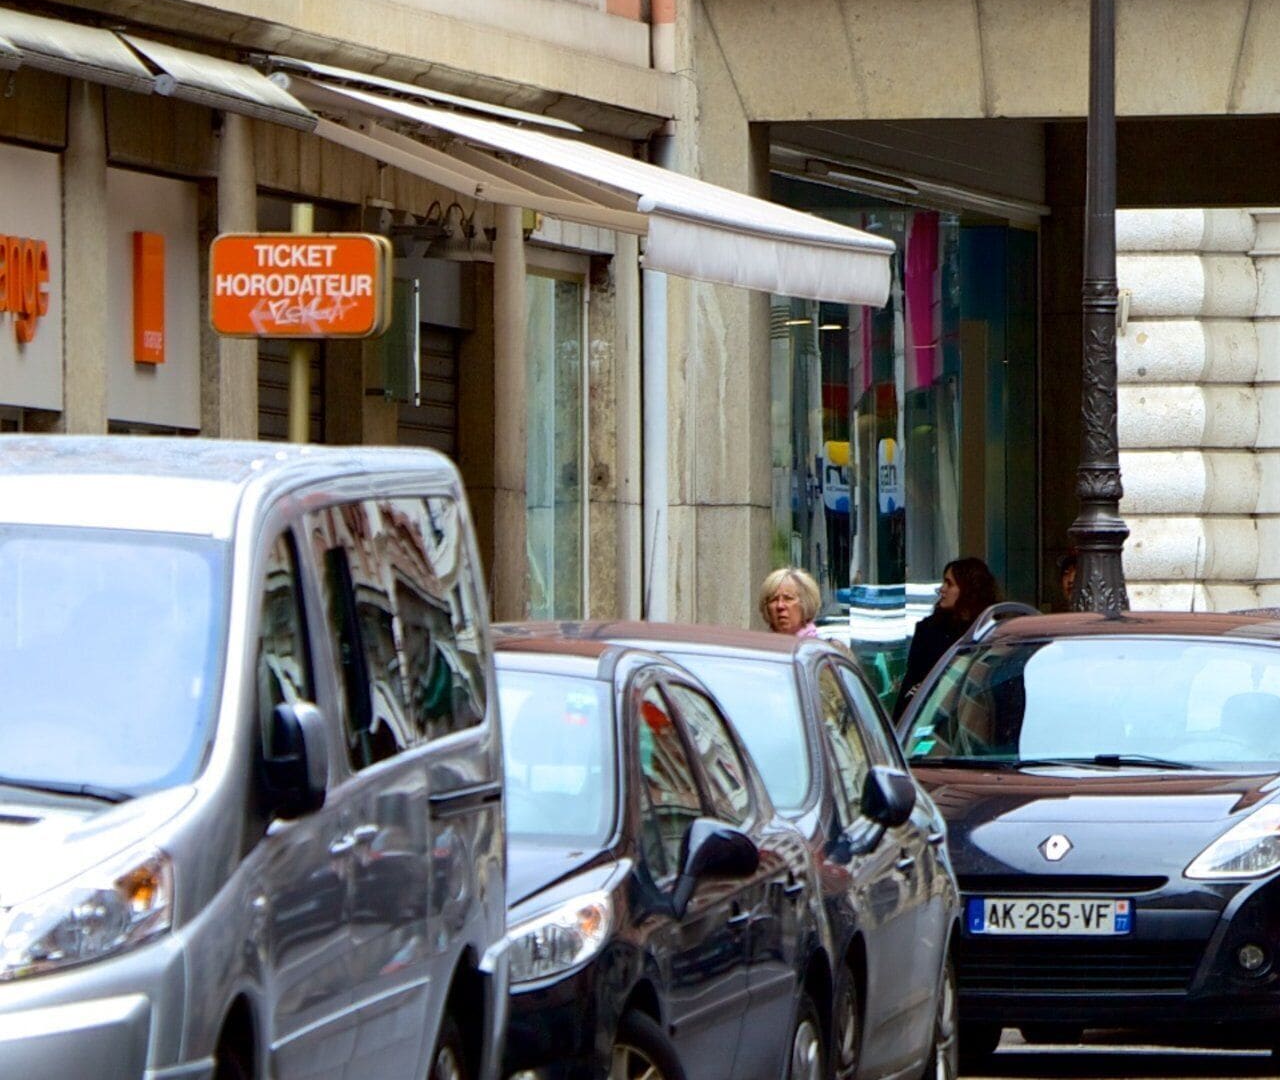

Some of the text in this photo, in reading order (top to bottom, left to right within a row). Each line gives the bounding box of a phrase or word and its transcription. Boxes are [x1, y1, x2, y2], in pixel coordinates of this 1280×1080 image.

[253, 244, 337, 268] TICKET
[215, 273, 373, 297] HORODATEUR
[987, 903, 1111, 929] AK-265-VF
